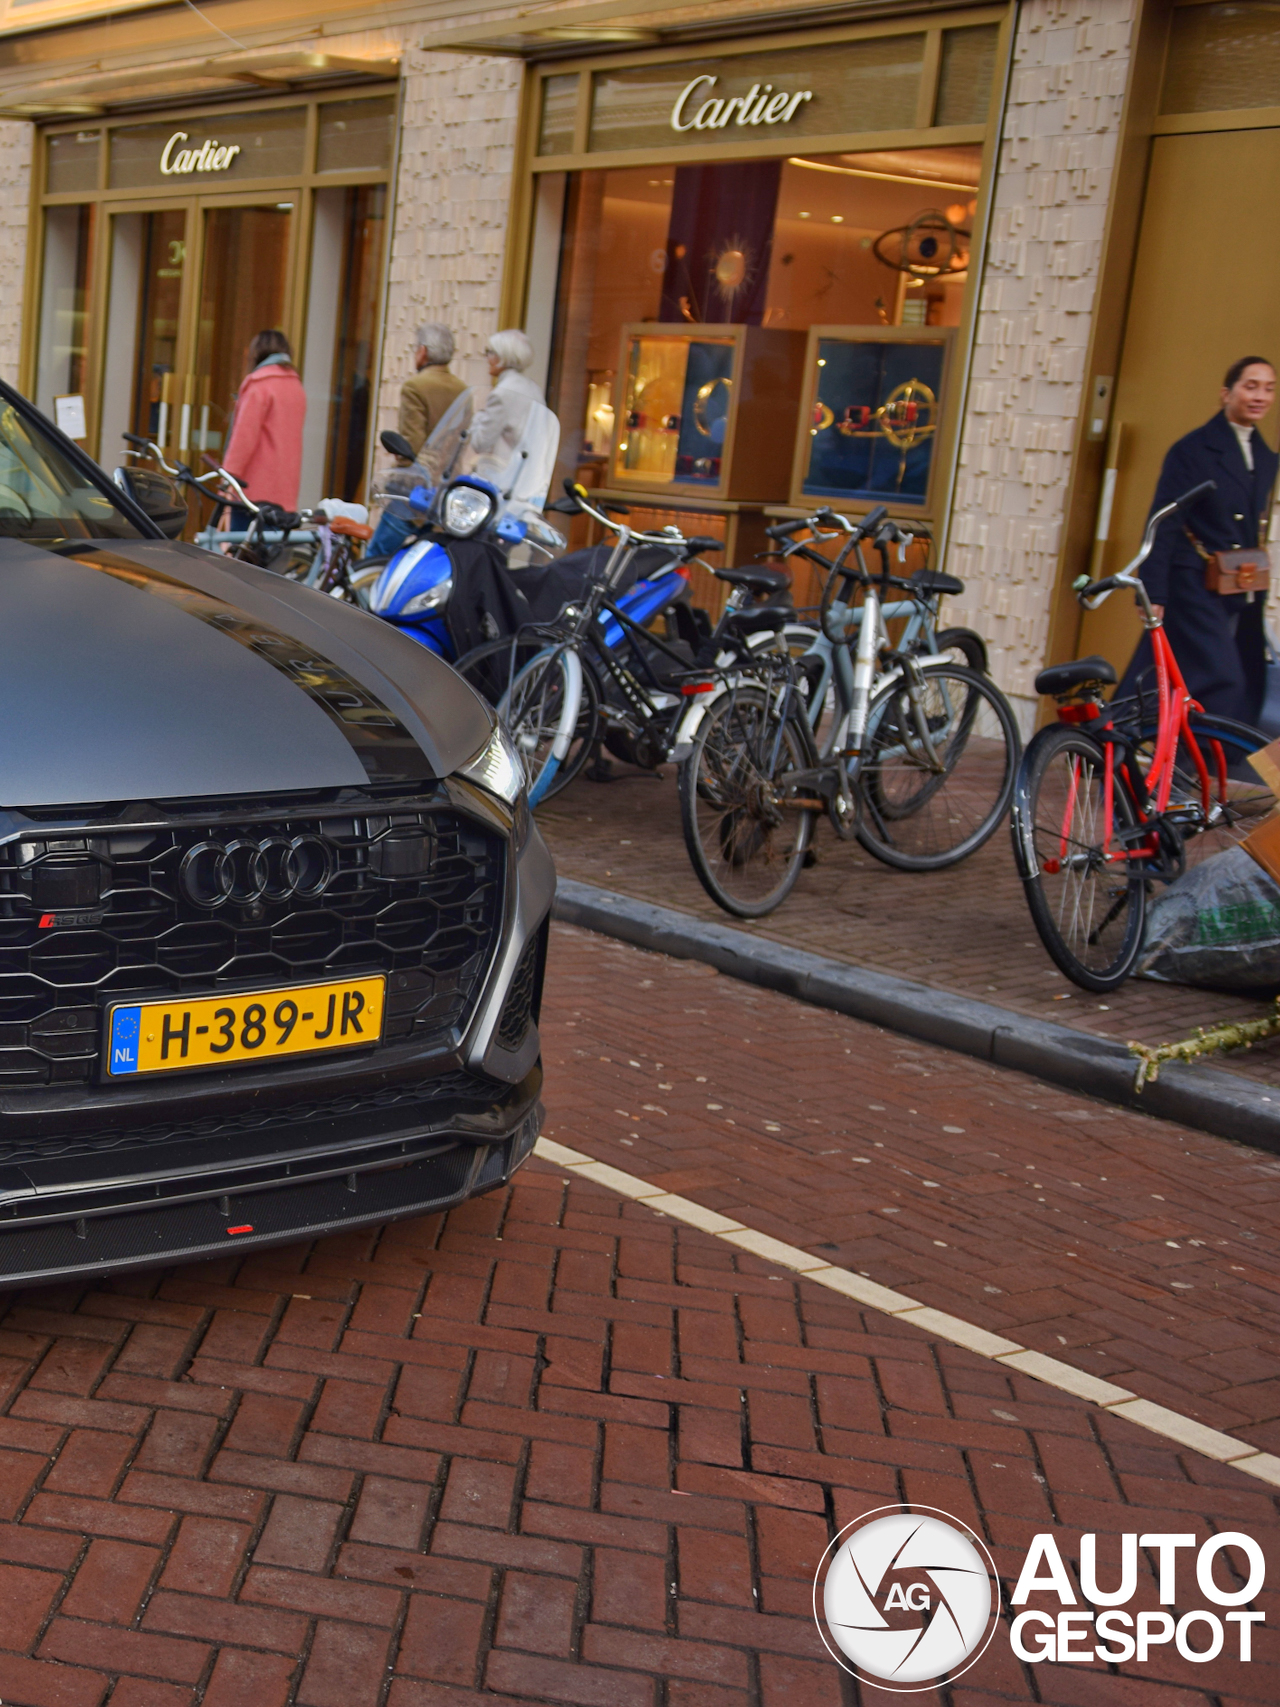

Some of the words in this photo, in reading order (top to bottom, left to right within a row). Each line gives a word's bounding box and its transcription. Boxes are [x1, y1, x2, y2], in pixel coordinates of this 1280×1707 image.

[671, 74, 812, 132] Cartier
[160, 131, 240, 175] Cartier
[160, 990, 365, 1060] H-389-JR
[115, 1047, 134, 1063] NL
